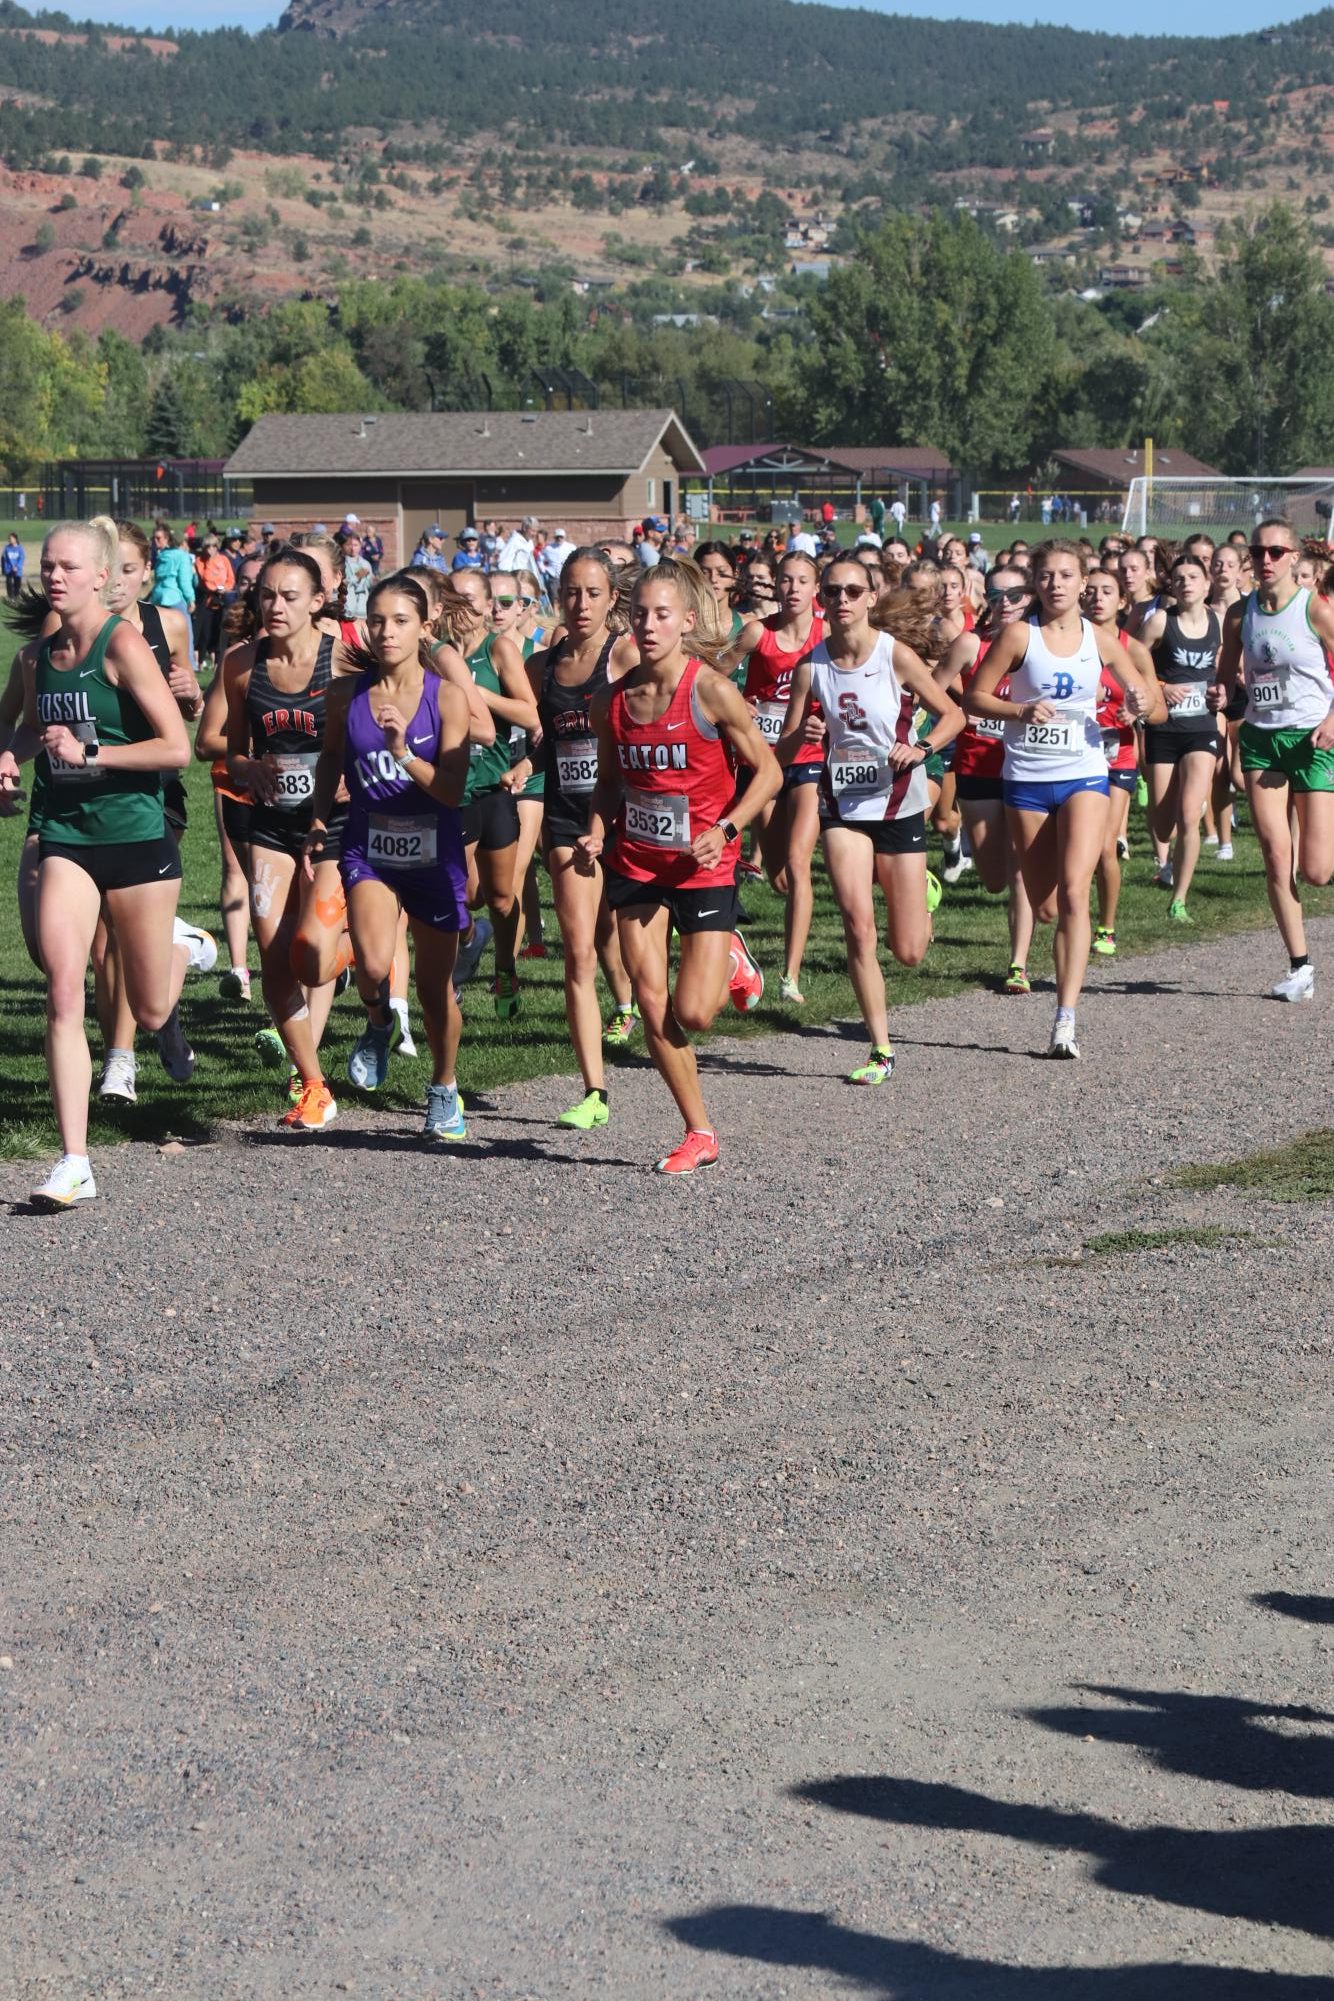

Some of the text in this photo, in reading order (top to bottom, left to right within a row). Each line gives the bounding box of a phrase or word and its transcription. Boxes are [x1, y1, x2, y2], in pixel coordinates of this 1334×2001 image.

[1051, 671, 1075, 700] B
[37, 691, 97, 722] FOSSIL
[262, 708, 318, 737] ERIE
[553, 709, 594, 733] ERI
[756, 716, 783, 735] 330
[1027, 726, 1070, 746] 3251
[617, 744, 688, 771] EATON
[560, 759, 599, 782] 3582
[834, 765, 878, 785] 4580
[275, 774, 311, 795] 583
[628, 807, 673, 837] 3532
[370, 833, 422, 858] 4082
